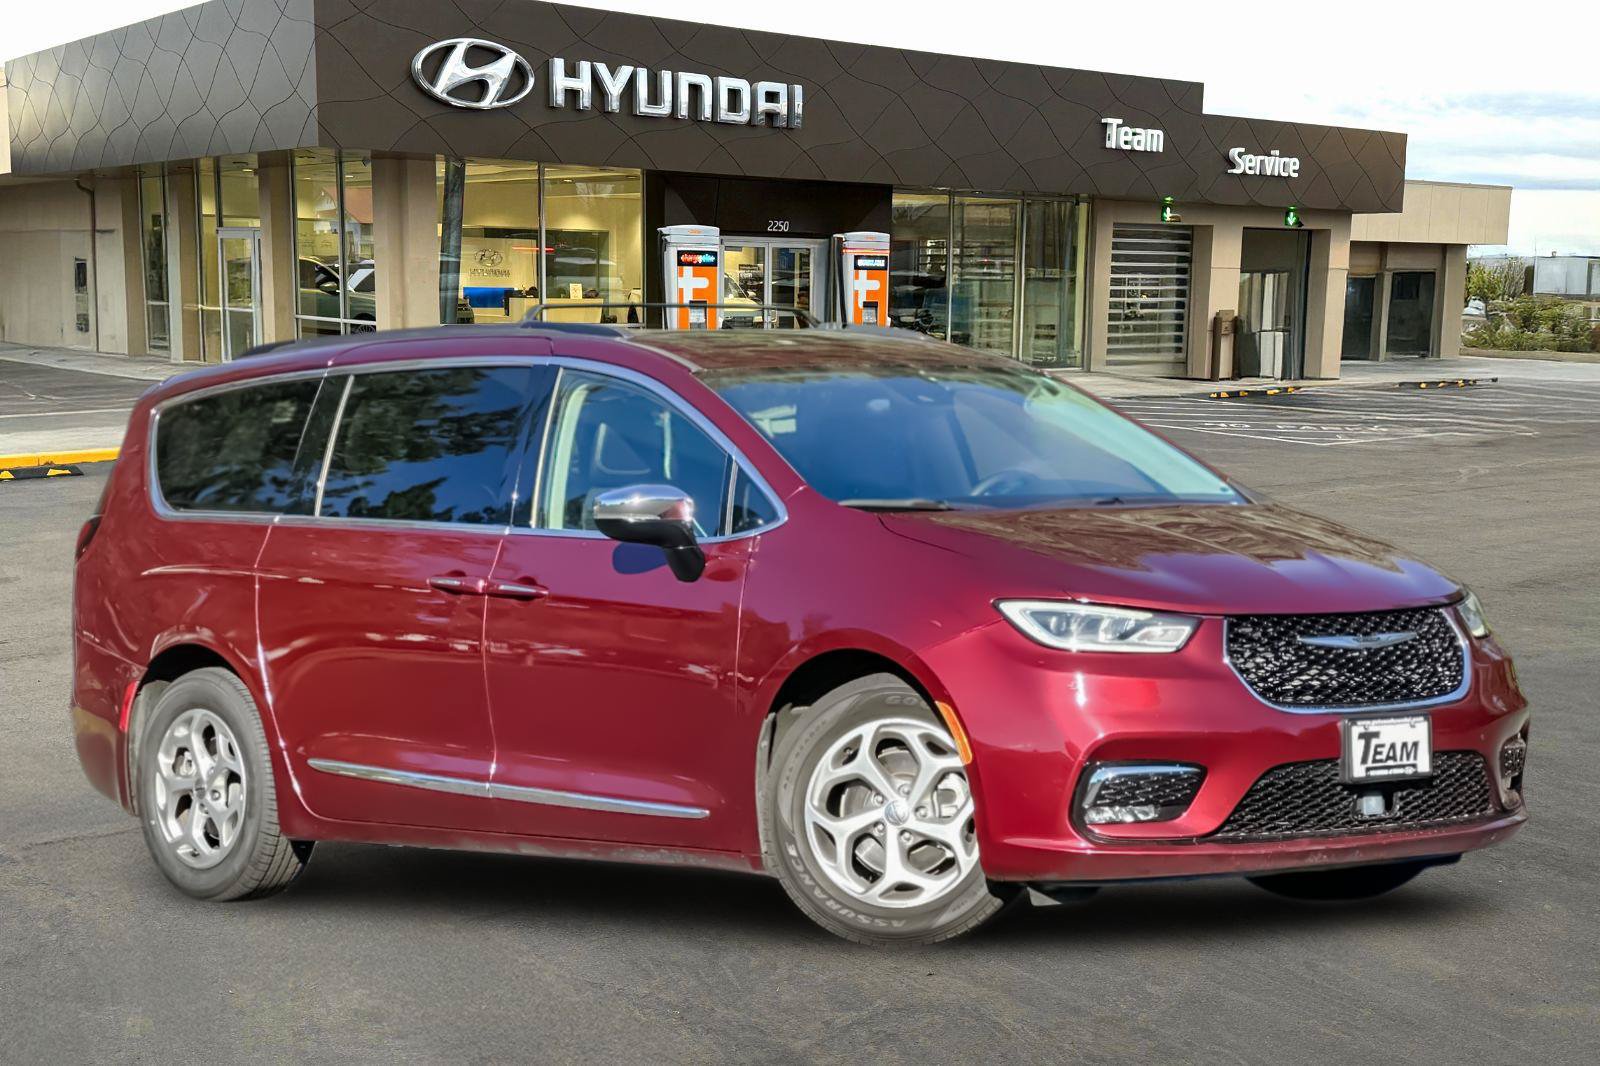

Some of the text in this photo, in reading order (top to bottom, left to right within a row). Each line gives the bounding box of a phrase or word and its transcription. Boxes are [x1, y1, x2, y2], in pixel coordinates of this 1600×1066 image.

[548, 56, 804, 130] HYUNDAI
[1101, 117, 1164, 153] Team
[1227, 146, 1300, 178] Service
[767, 220, 790, 232] 2250
[1357, 730, 1420, 766] TEAM
